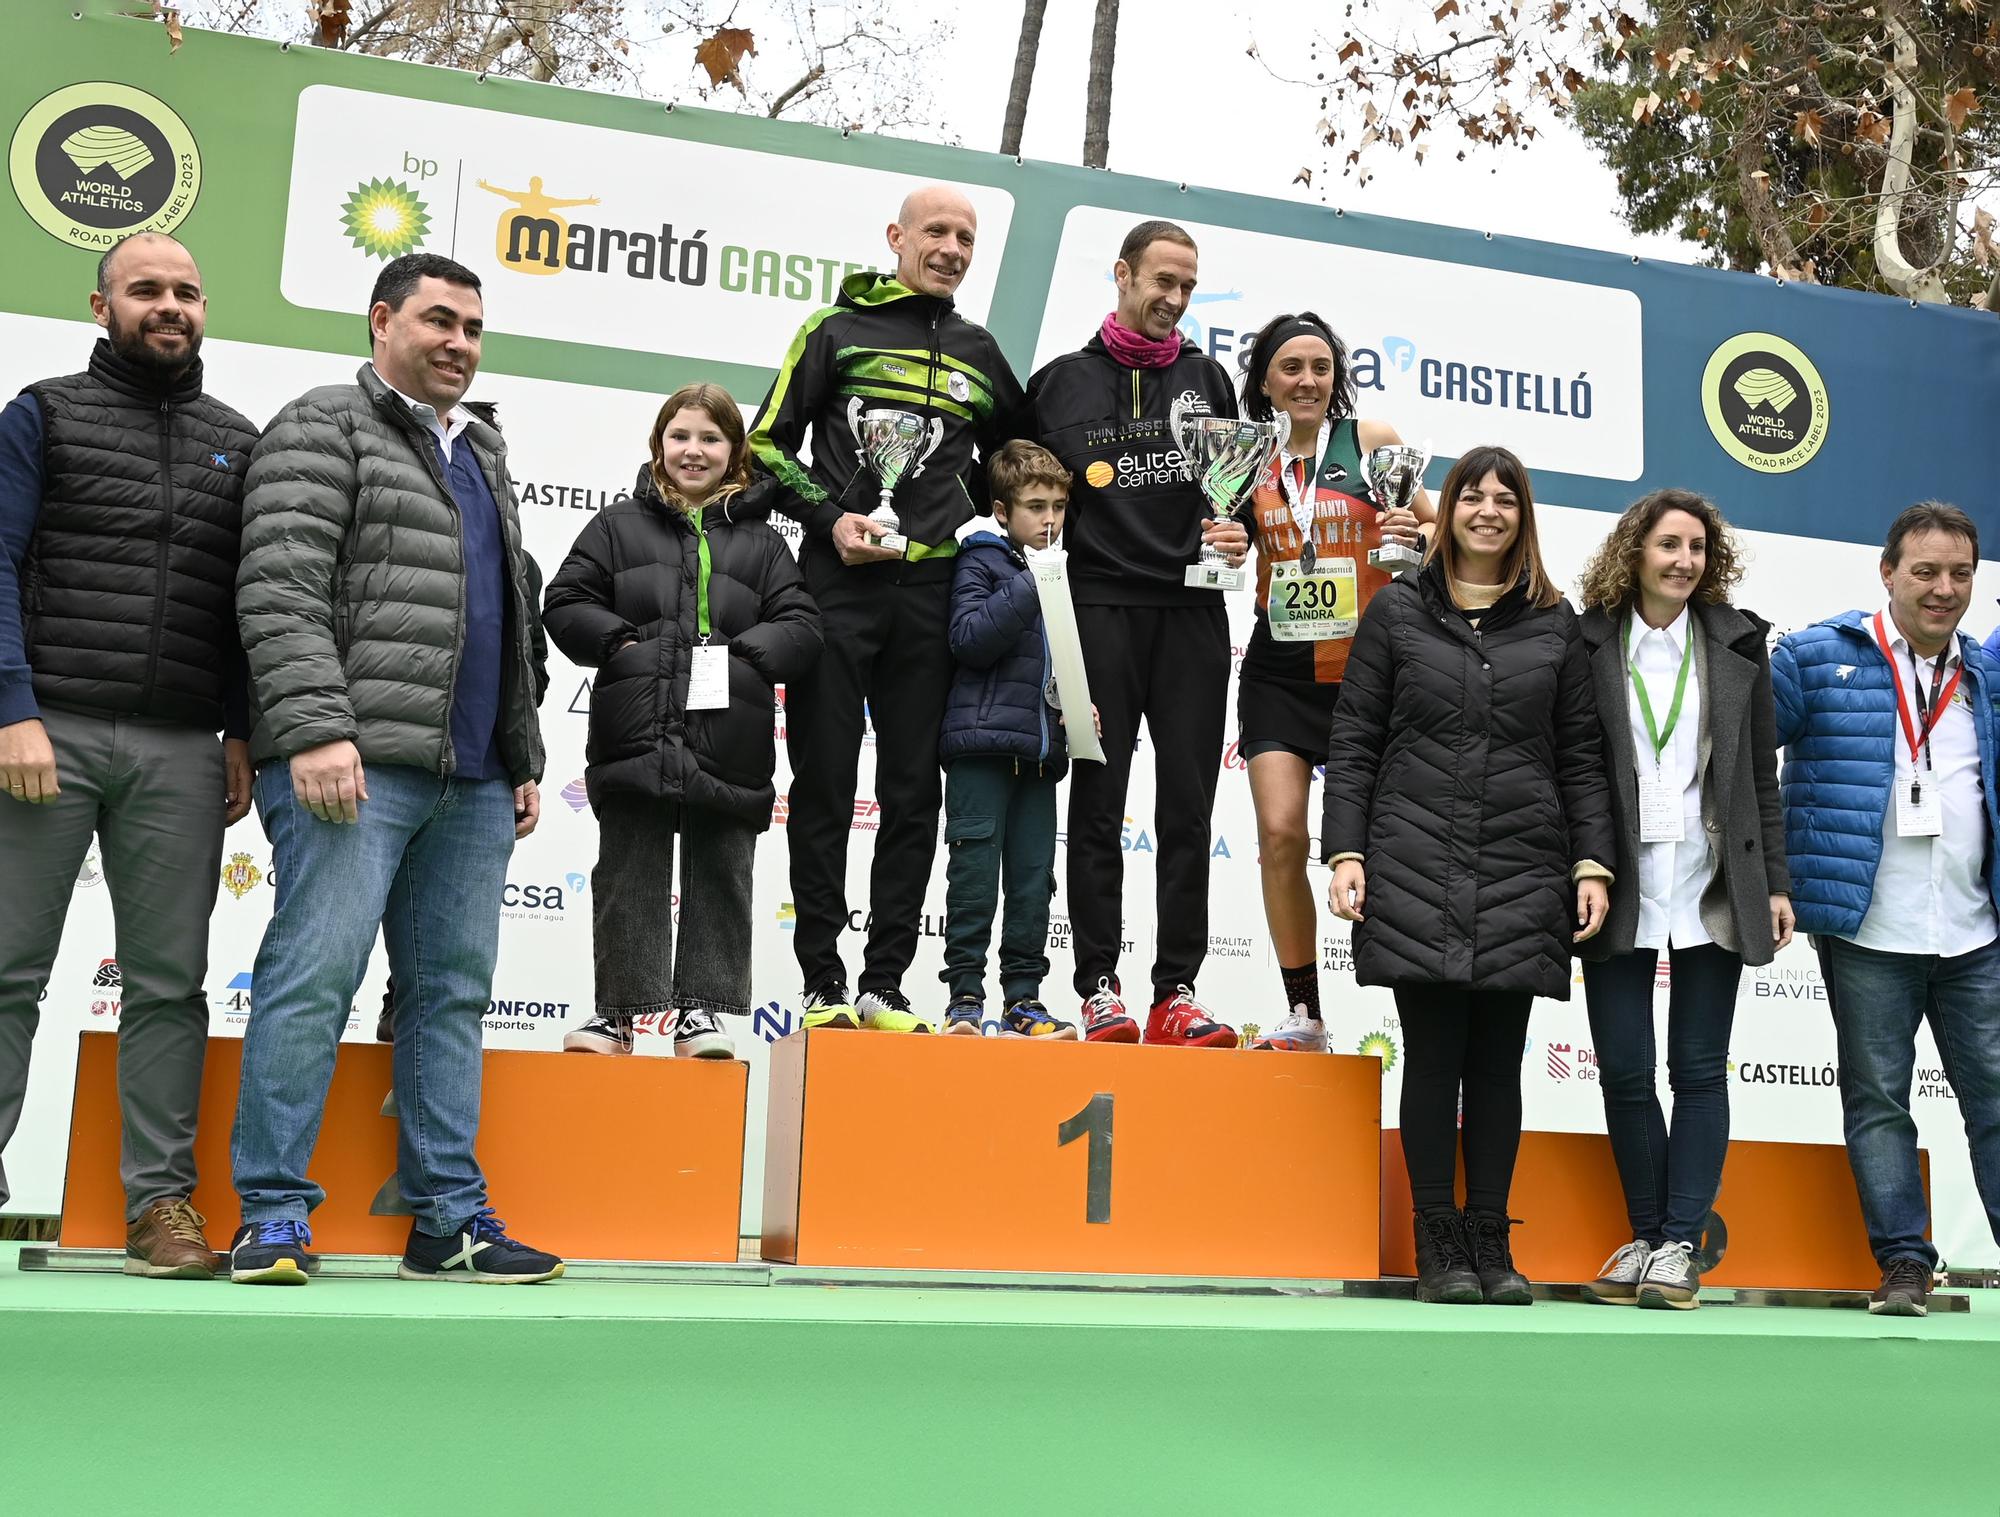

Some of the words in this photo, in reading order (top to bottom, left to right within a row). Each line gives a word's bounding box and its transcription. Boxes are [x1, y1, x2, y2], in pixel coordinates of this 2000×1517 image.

[403, 151, 439, 180] bp
[76, 179, 132, 198] WORLD
[60, 191, 144, 213] ATHLETICS
[69, 227, 113, 245] ROAD
[155, 192, 190, 229] LABEL
[181, 153, 194, 189] 2023
[505, 215, 709, 287] marató
[1420, 358, 1592, 419] CASTELLÓ
[1813, 389, 1825, 420] 2023
[1747, 413, 1786, 428] WORLD
[1738, 423, 1795, 440] ATHLETICS
[1804, 422, 1824, 454] LABEL
[1747, 453, 1778, 469] ROAD
[1779, 450, 1805, 468] RACE
[1117, 468, 1186, 488] cement
[1314, 499, 1349, 518] TANYA
[1259, 519, 1363, 555] VILAAMÉS
[1285, 580, 1337, 609] 230
[1289, 609, 1335, 620] SANDRA
[502, 884, 564, 910] csa
[1050, 937, 1068, 949] DE
[1209, 936, 1253, 947] ERALITAT
[1324, 937, 1352, 946] FUND
[1207, 946, 1251, 958] ENCIANA
[1323, 947, 1354, 959] TRIN
[1323, 960, 1356, 972] ALFO
[1755, 981, 1827, 1001] BAVIE
[484, 1000, 570, 1019] ONFORT
[1383, 1016, 1400, 1030] bp
[1578, 1067, 1595, 1081] de
[1740, 1062, 1841, 1087] CASTELLÓ
[1918, 1085, 1959, 1099] ATHL
[1057, 1093, 1115, 1225] 1
